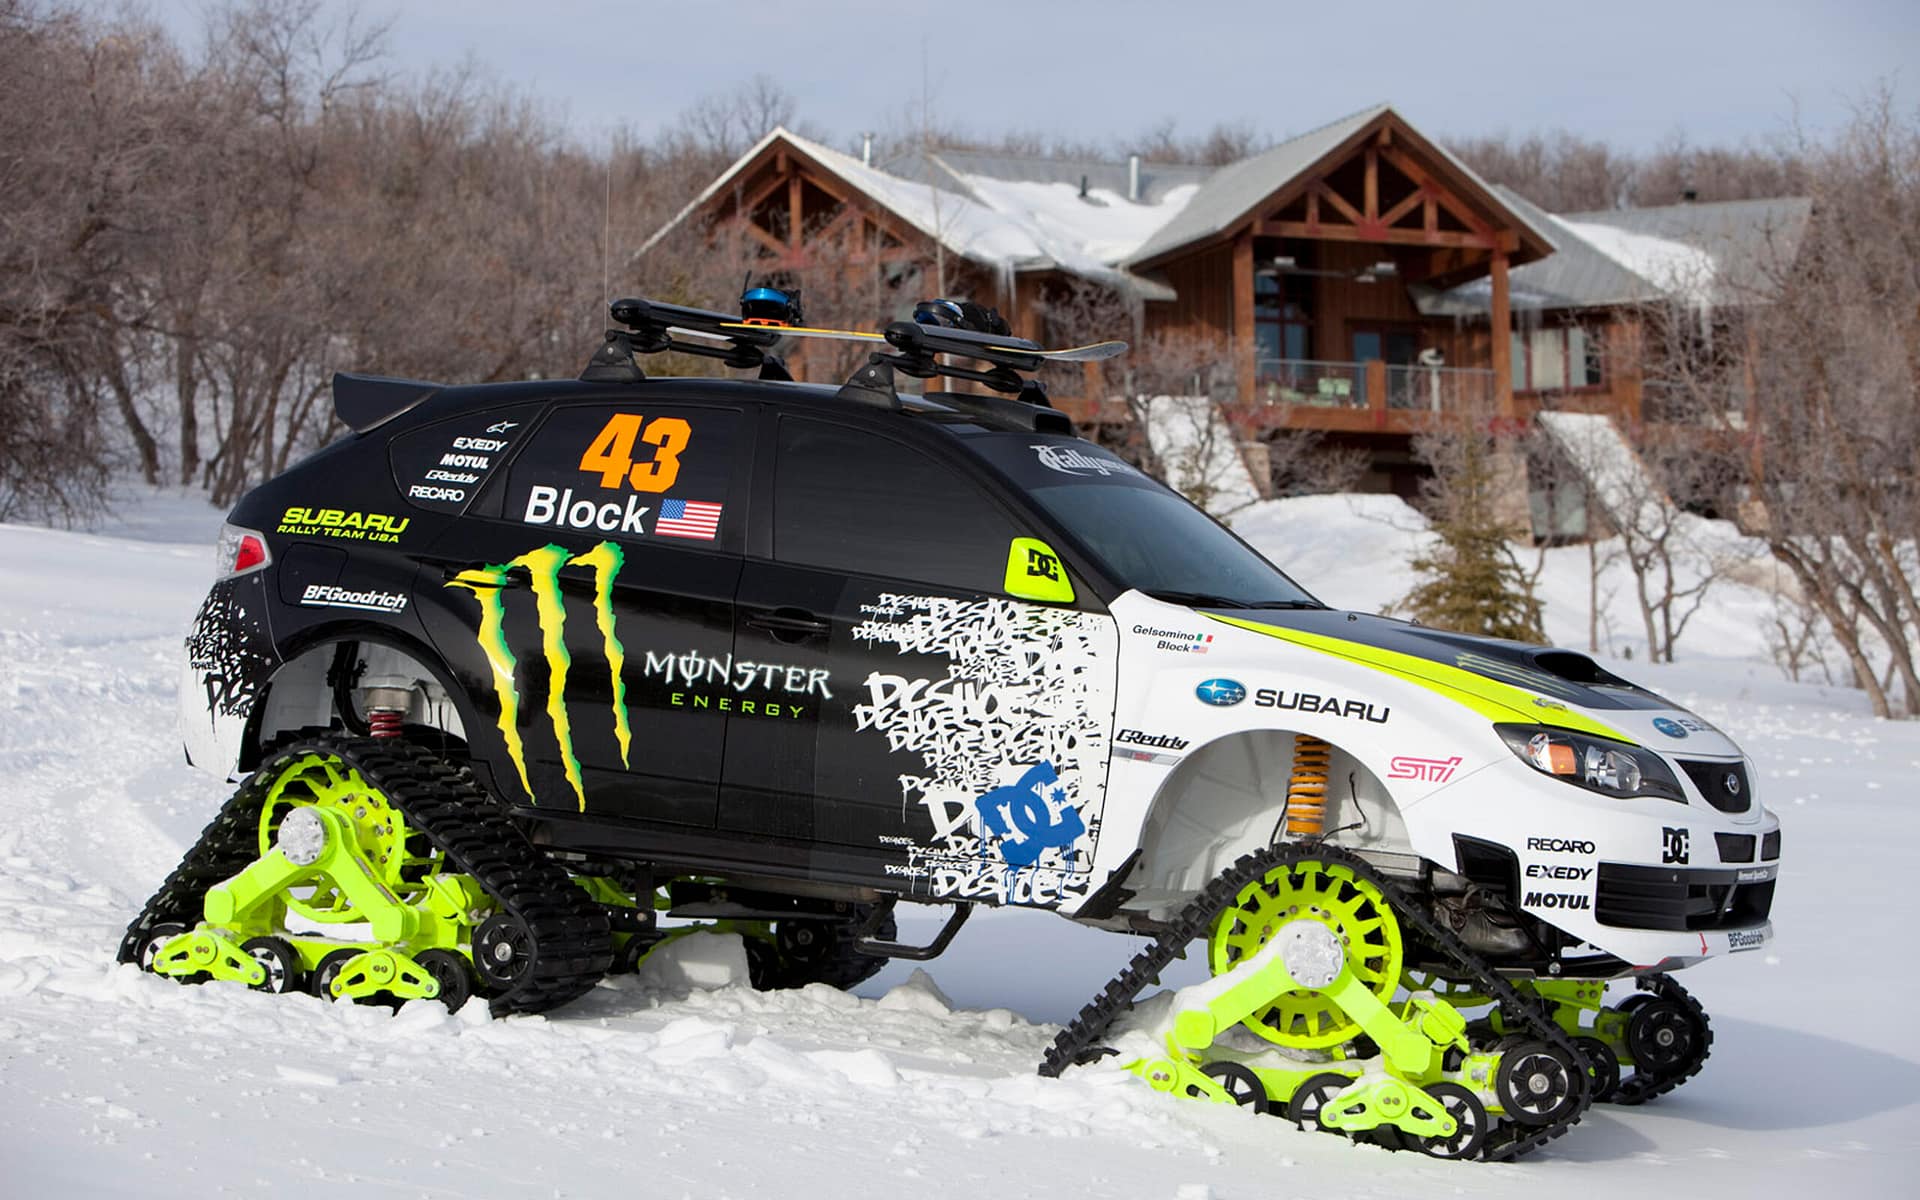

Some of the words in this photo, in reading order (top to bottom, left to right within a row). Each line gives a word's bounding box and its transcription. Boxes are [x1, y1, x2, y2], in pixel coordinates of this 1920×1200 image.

[452, 437, 508, 452] EXEDY
[578, 413, 692, 494] 43
[439, 453, 489, 469] MOTUL
[409, 485, 465, 502] RECARO
[523, 485, 650, 534] Block
[281, 507, 410, 533] SUBARU
[276, 524, 321, 536] RALLY
[323, 527, 365, 540] TEAM
[368, 532, 400, 544] USA
[301, 584, 408, 610] BFGoodrich
[1132, 624, 1195, 641] Gelsomino
[1156, 640, 1191, 653] Block
[671, 692, 805, 719] ENERGY
[1254, 688, 1390, 724] SUBARU
[1527, 837, 1596, 854] RECARO
[1525, 864, 1593, 881] EXEDY
[1523, 892, 1591, 910] MOTUL
